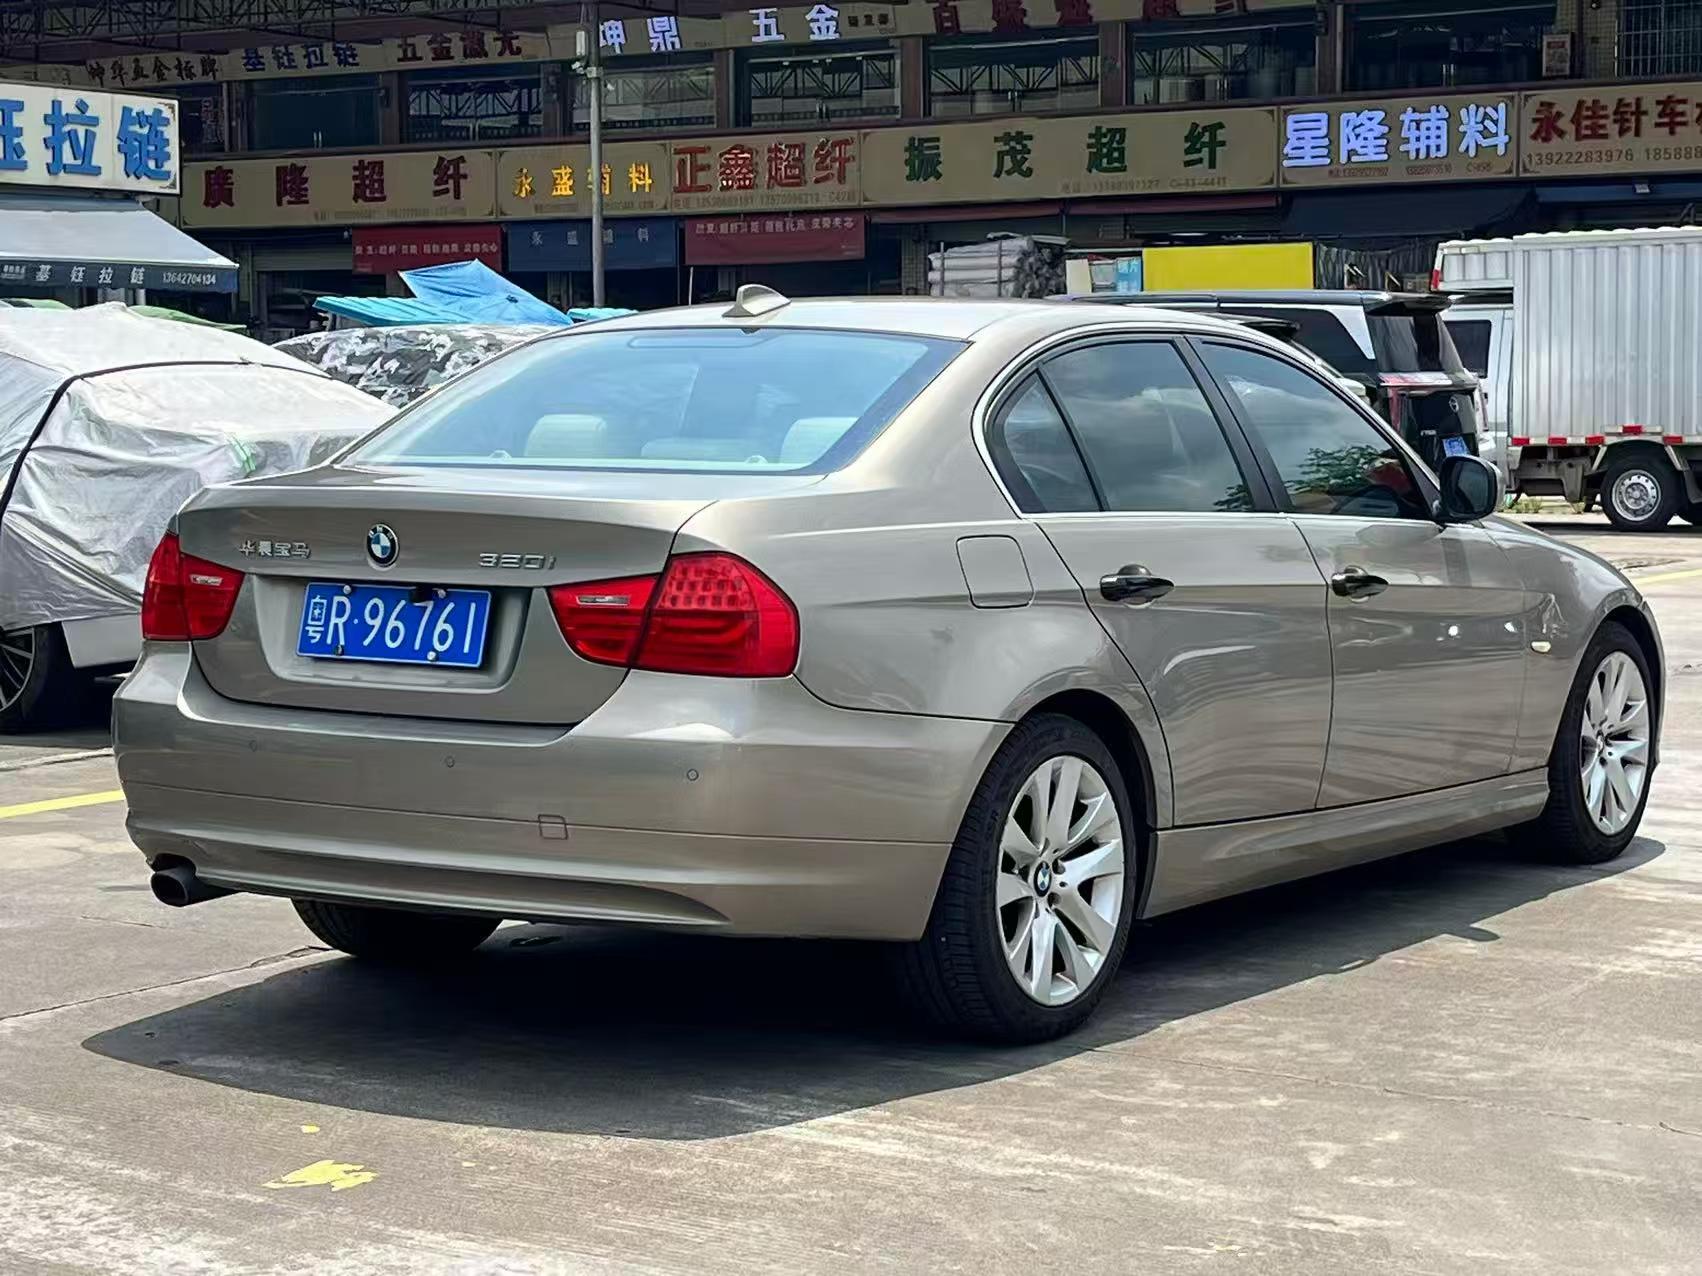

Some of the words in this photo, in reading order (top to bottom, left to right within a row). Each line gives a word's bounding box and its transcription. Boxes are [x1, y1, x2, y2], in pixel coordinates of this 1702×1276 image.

[904, 121, 1226, 182] 振茂超纤
[1282, 102, 1509, 168] 星隆辅料
[202, 155, 468, 208] 廣隆超纤
[673, 138, 855, 194] 正鑫超纤
[35, 264, 145, 284] 基钰拉链
[238, 540, 311, 559] 华晨宝马
[478, 553, 556, 570] 320i
